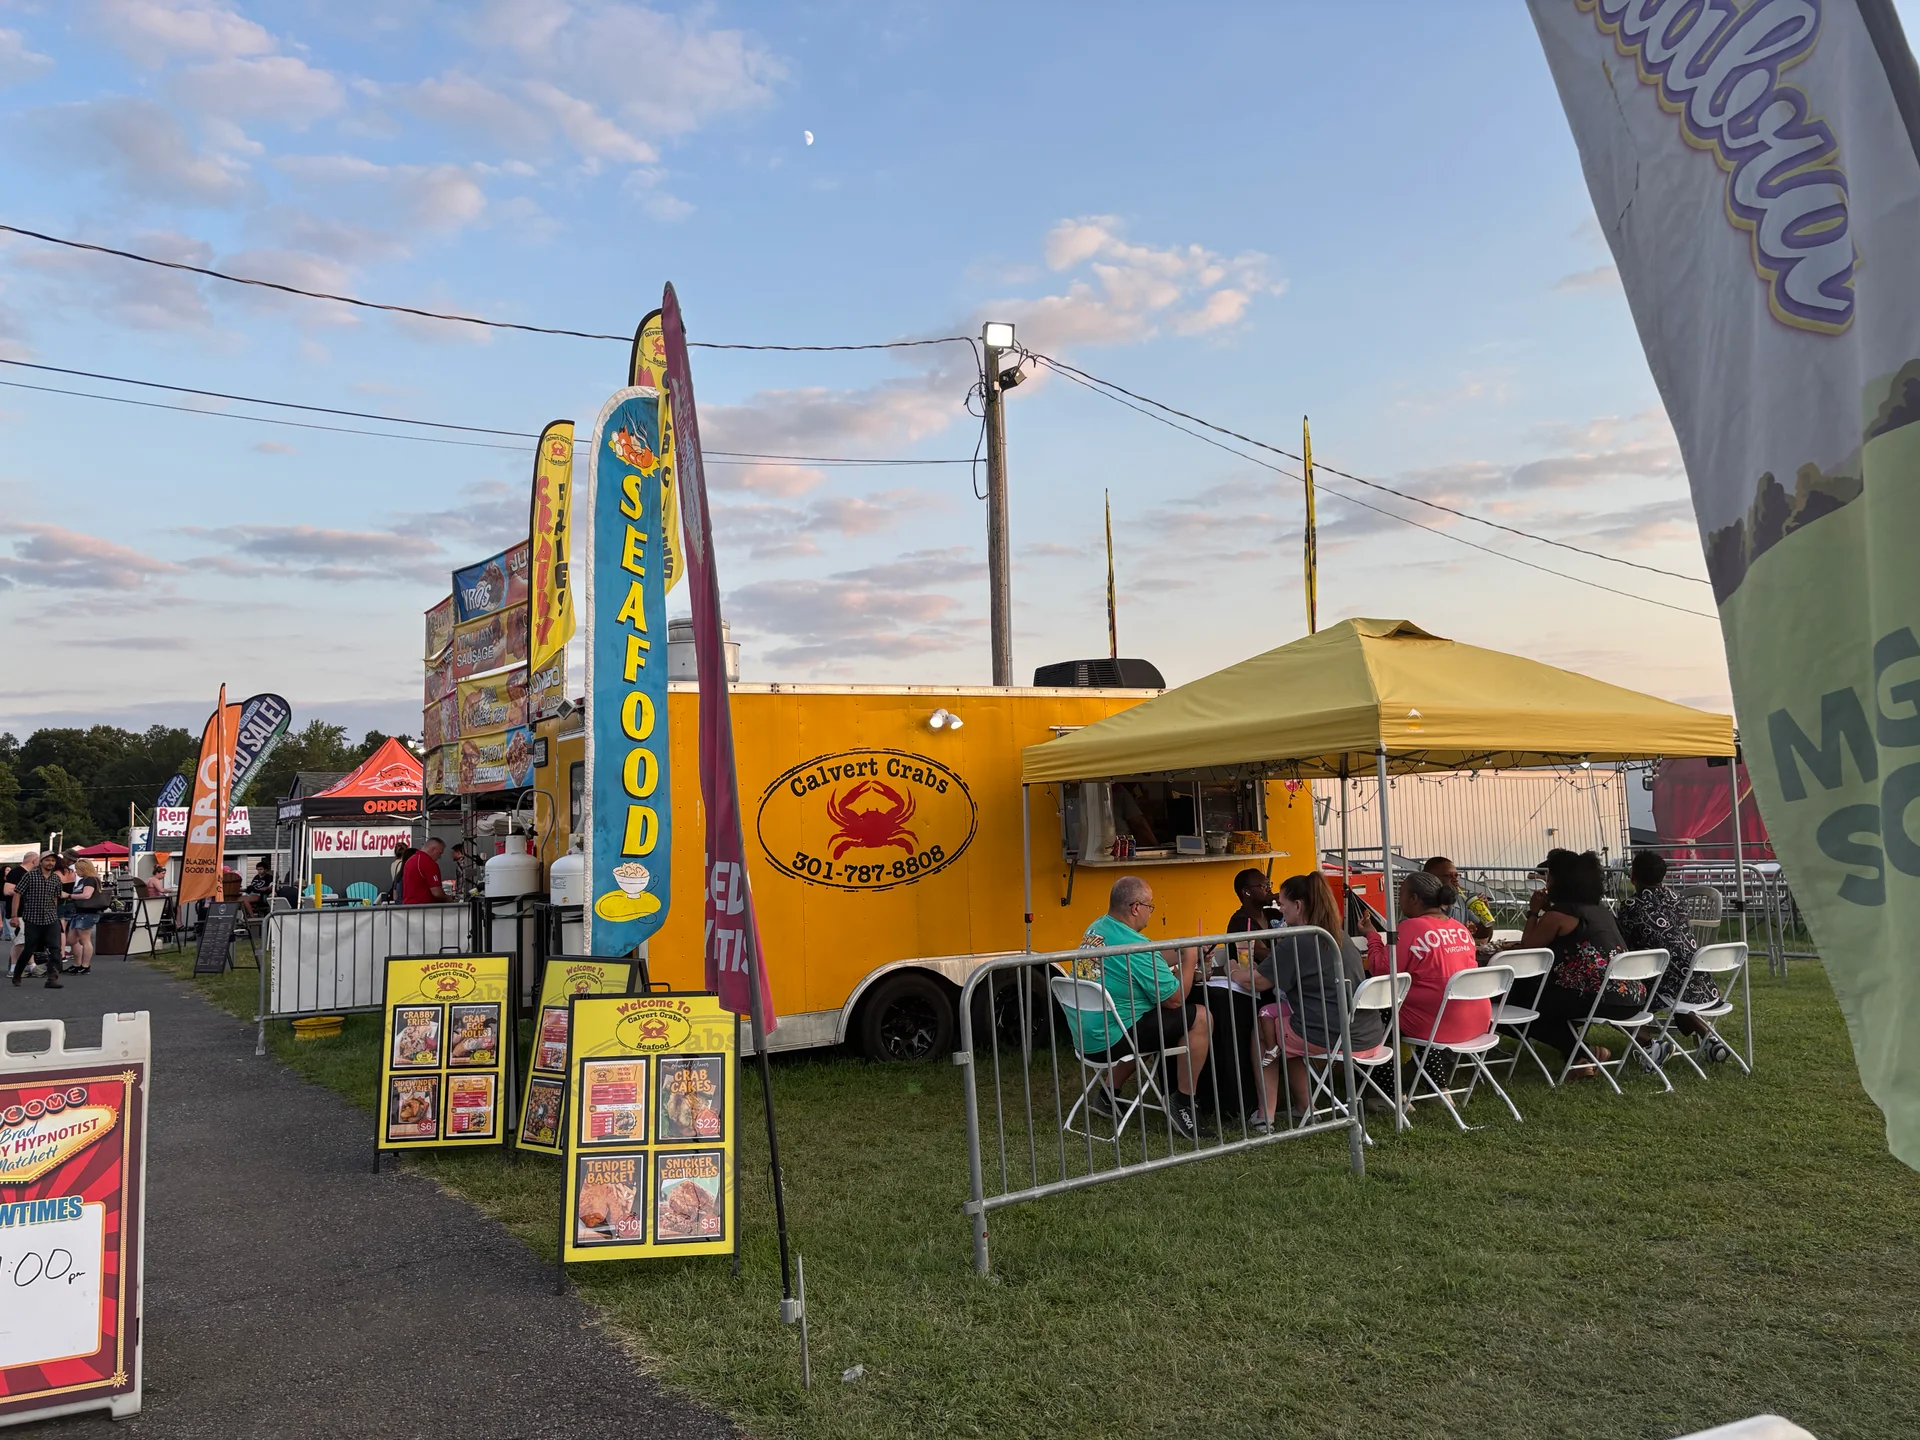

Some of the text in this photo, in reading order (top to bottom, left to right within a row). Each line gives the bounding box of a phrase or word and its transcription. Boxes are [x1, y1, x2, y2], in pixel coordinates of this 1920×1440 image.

[461, 582, 492, 612] YROS
[455, 625, 495, 652] ITALIAN
[455, 644, 495, 668] SAUSAGE
[614, 474, 660, 858] SEAFOOD
[239, 696, 286, 753] SALE!
[790, 757, 949, 797] Calvert Crabs
[158, 807, 248, 822] Ren wn
[313, 829, 411, 856] We Sell Carports
[791, 844, 946, 883] 301-787-8808
[1444, 945, 1471, 954] VIRGINIA
[420, 961, 477, 974] Welcome To
[566, 963, 605, 979] Welcome To
[434, 993, 460, 1001] Seafood
[616, 999, 692, 1016] Welcome To
[403, 1010, 435, 1020] CRABBY
[462, 1014, 487, 1024] CRAB
[627, 1011, 682, 1024] Calvert Crabs
[407, 1019, 431, 1027] FRIES
[466, 1022, 484, 1031] EGG
[461, 1029, 488, 1038] ROLLS
[636, 1041, 670, 1050] Seafood
[674, 1069, 708, 1082] CRAB
[393, 1078, 437, 1088] SIDEWINDER
[670, 1080, 712, 1094] CAKES
[7, 1087, 83, 1122] COME
[419, 1122, 432, 1132] $6
[695, 1117, 718, 1129] $22
[0, 1120, 39, 1145] Brad
[14, 1118, 100, 1155] HYPNOTIST
[586, 1159, 636, 1173] TENDER
[665, 1156, 714, 1170] SNICKER
[586, 1170, 635, 1185] BASKET
[660, 1165, 719, 1180] EGG ROLLS
[618, 1219, 639, 1232] $10
[701, 1218, 716, 1230] $5
